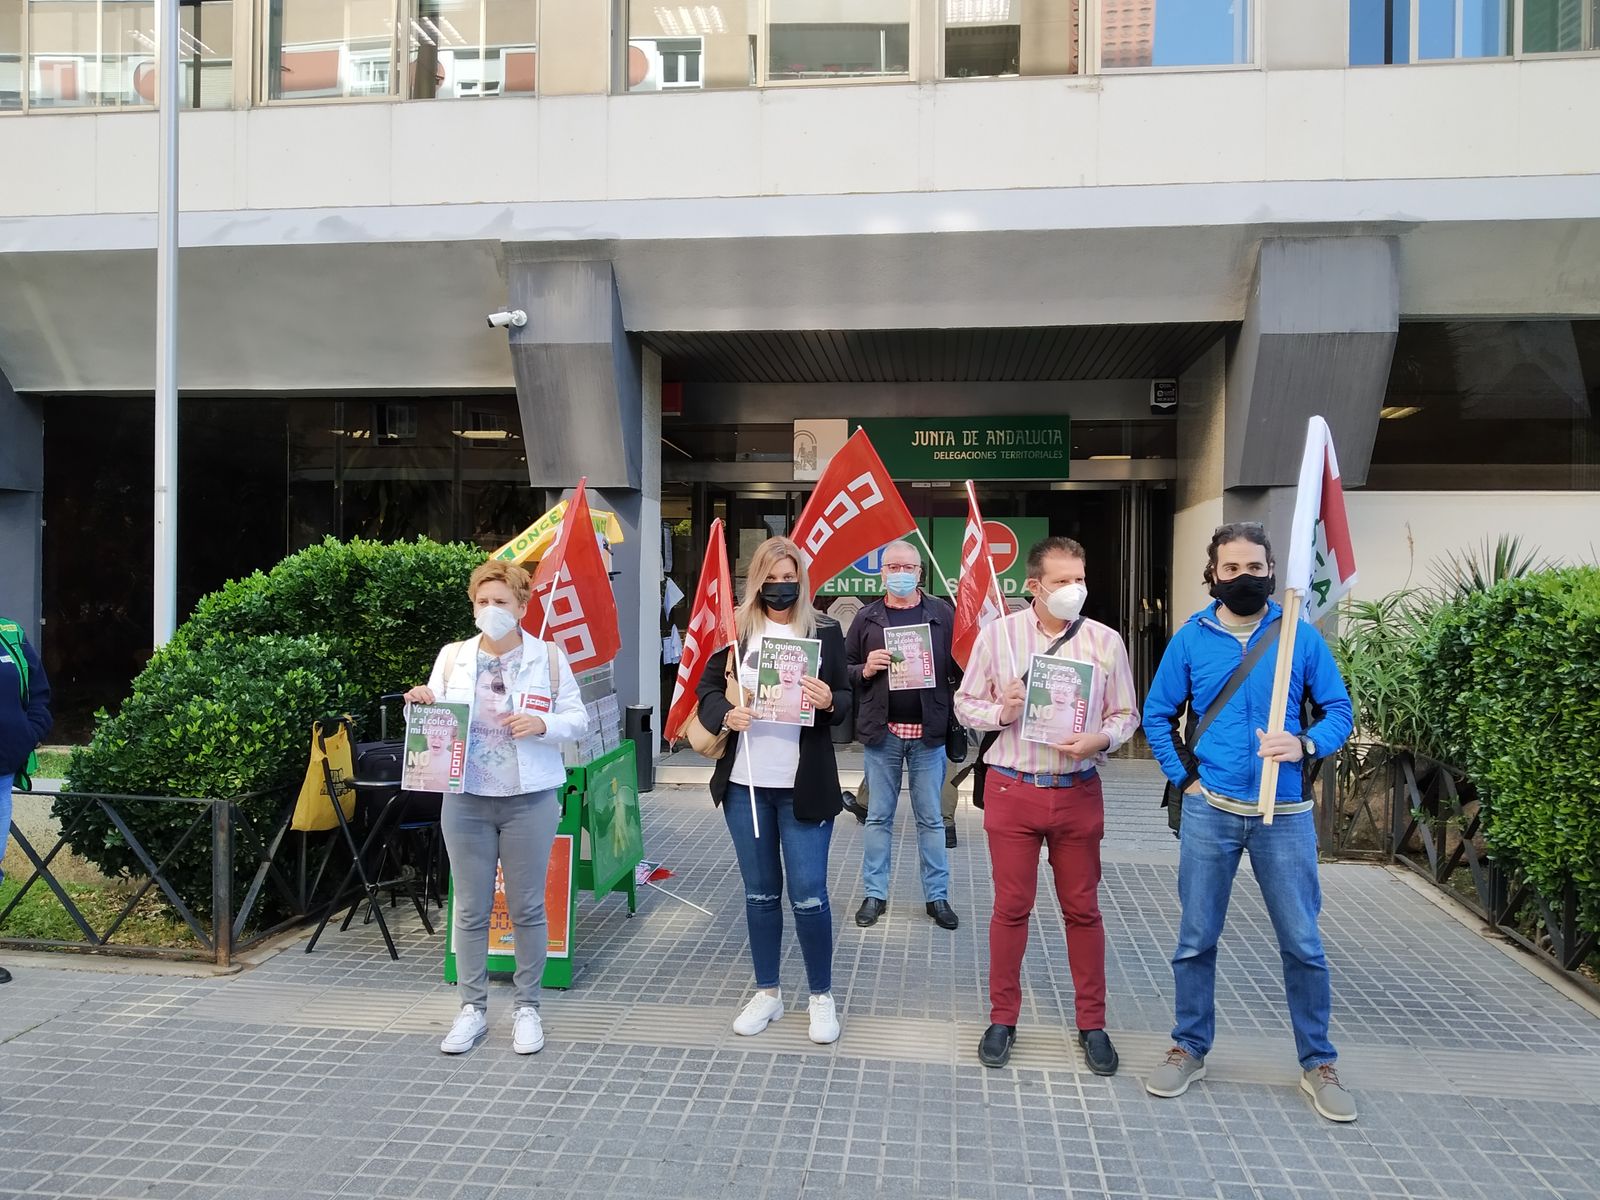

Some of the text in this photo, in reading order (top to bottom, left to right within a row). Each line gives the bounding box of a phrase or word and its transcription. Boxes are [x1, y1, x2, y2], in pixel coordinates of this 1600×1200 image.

[911, 430, 955, 446] JUNTA
[962, 430, 979, 446] DE
[934, 449, 1063, 460] DELEGACIONES TERRITORIALES
[516, 510, 561, 551] ONCE
[764, 640, 802, 652] Yo quiero
[762, 650, 809, 663] ir al cole de
[761, 660, 799, 671] mi barrio
[891, 661, 909, 673] NO
[1036, 659, 1046, 669] Yo
[1033, 669, 1041, 678] ir
[1041, 671, 1050, 680] al
[1071, 675, 1082, 685] de
[1032, 680, 1044, 688] mi
[760, 684, 783, 699] NO
[412, 704, 451, 716] Yo quiero
[1029, 703, 1055, 719] NO
[411, 716, 458, 727] ir al cole de
[410, 724, 448, 736] mi barrio
[408, 751, 431, 767] NO
[451, 742, 463, 777] CCOO
